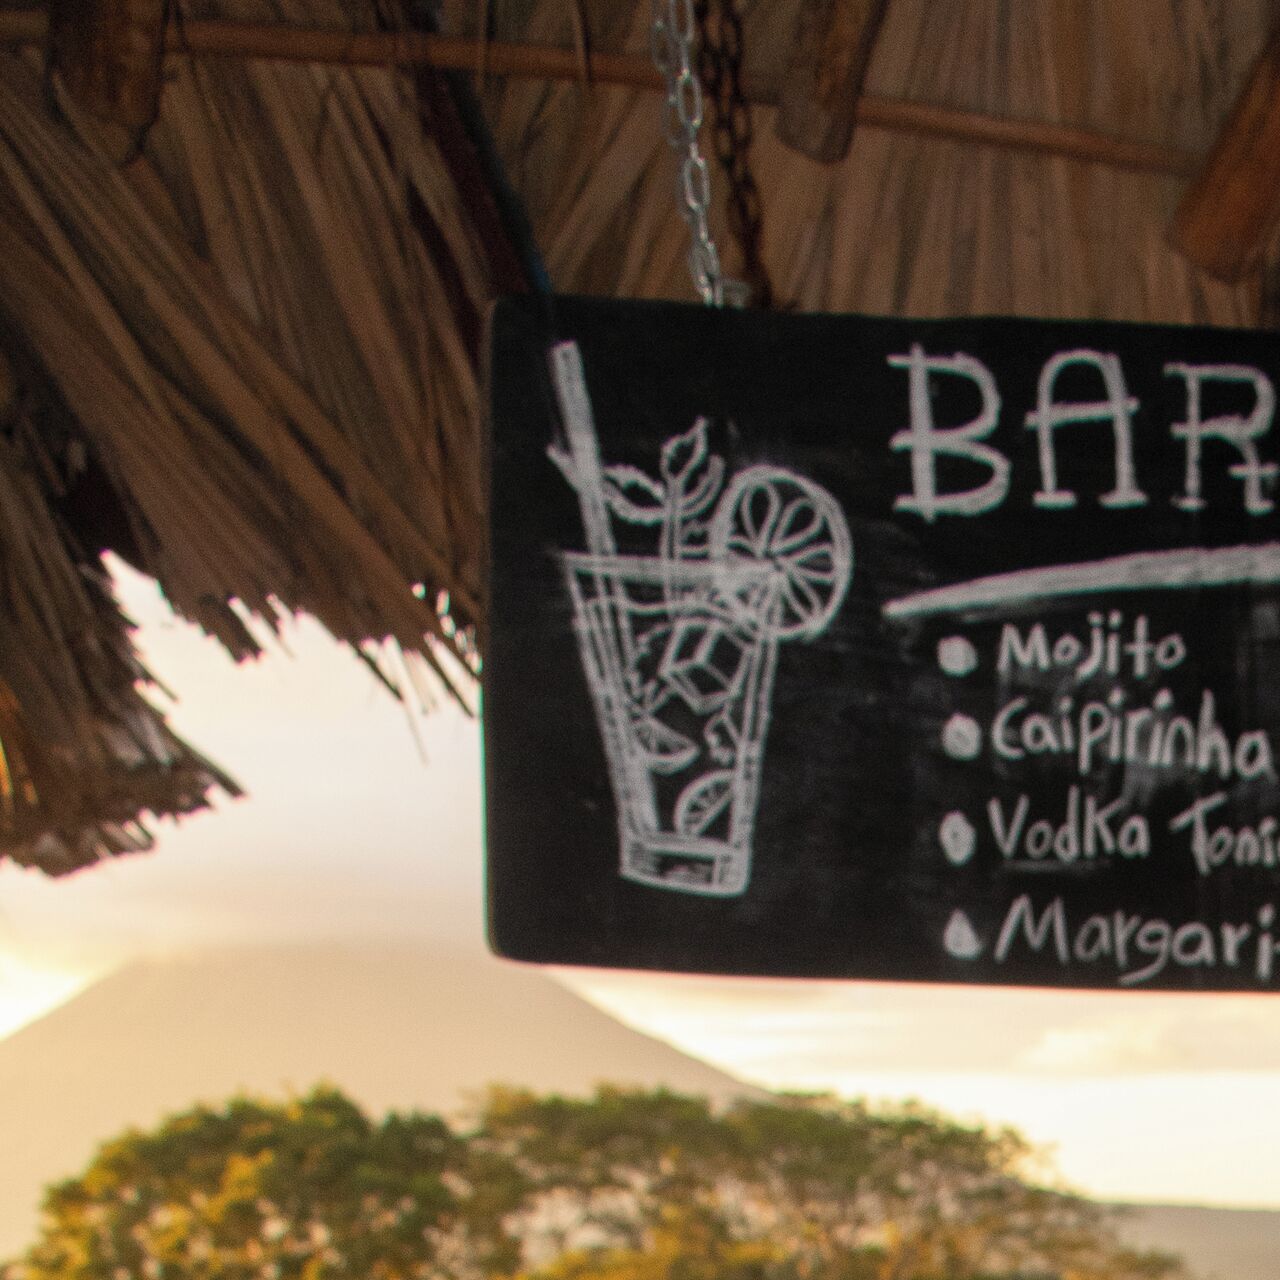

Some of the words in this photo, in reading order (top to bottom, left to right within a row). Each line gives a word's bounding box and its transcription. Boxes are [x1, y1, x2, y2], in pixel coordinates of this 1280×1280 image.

[886, 344, 1280, 523] BAR
[998, 610, 1188, 684] Mojito
[991, 687, 1279, 784] Caipirinha
